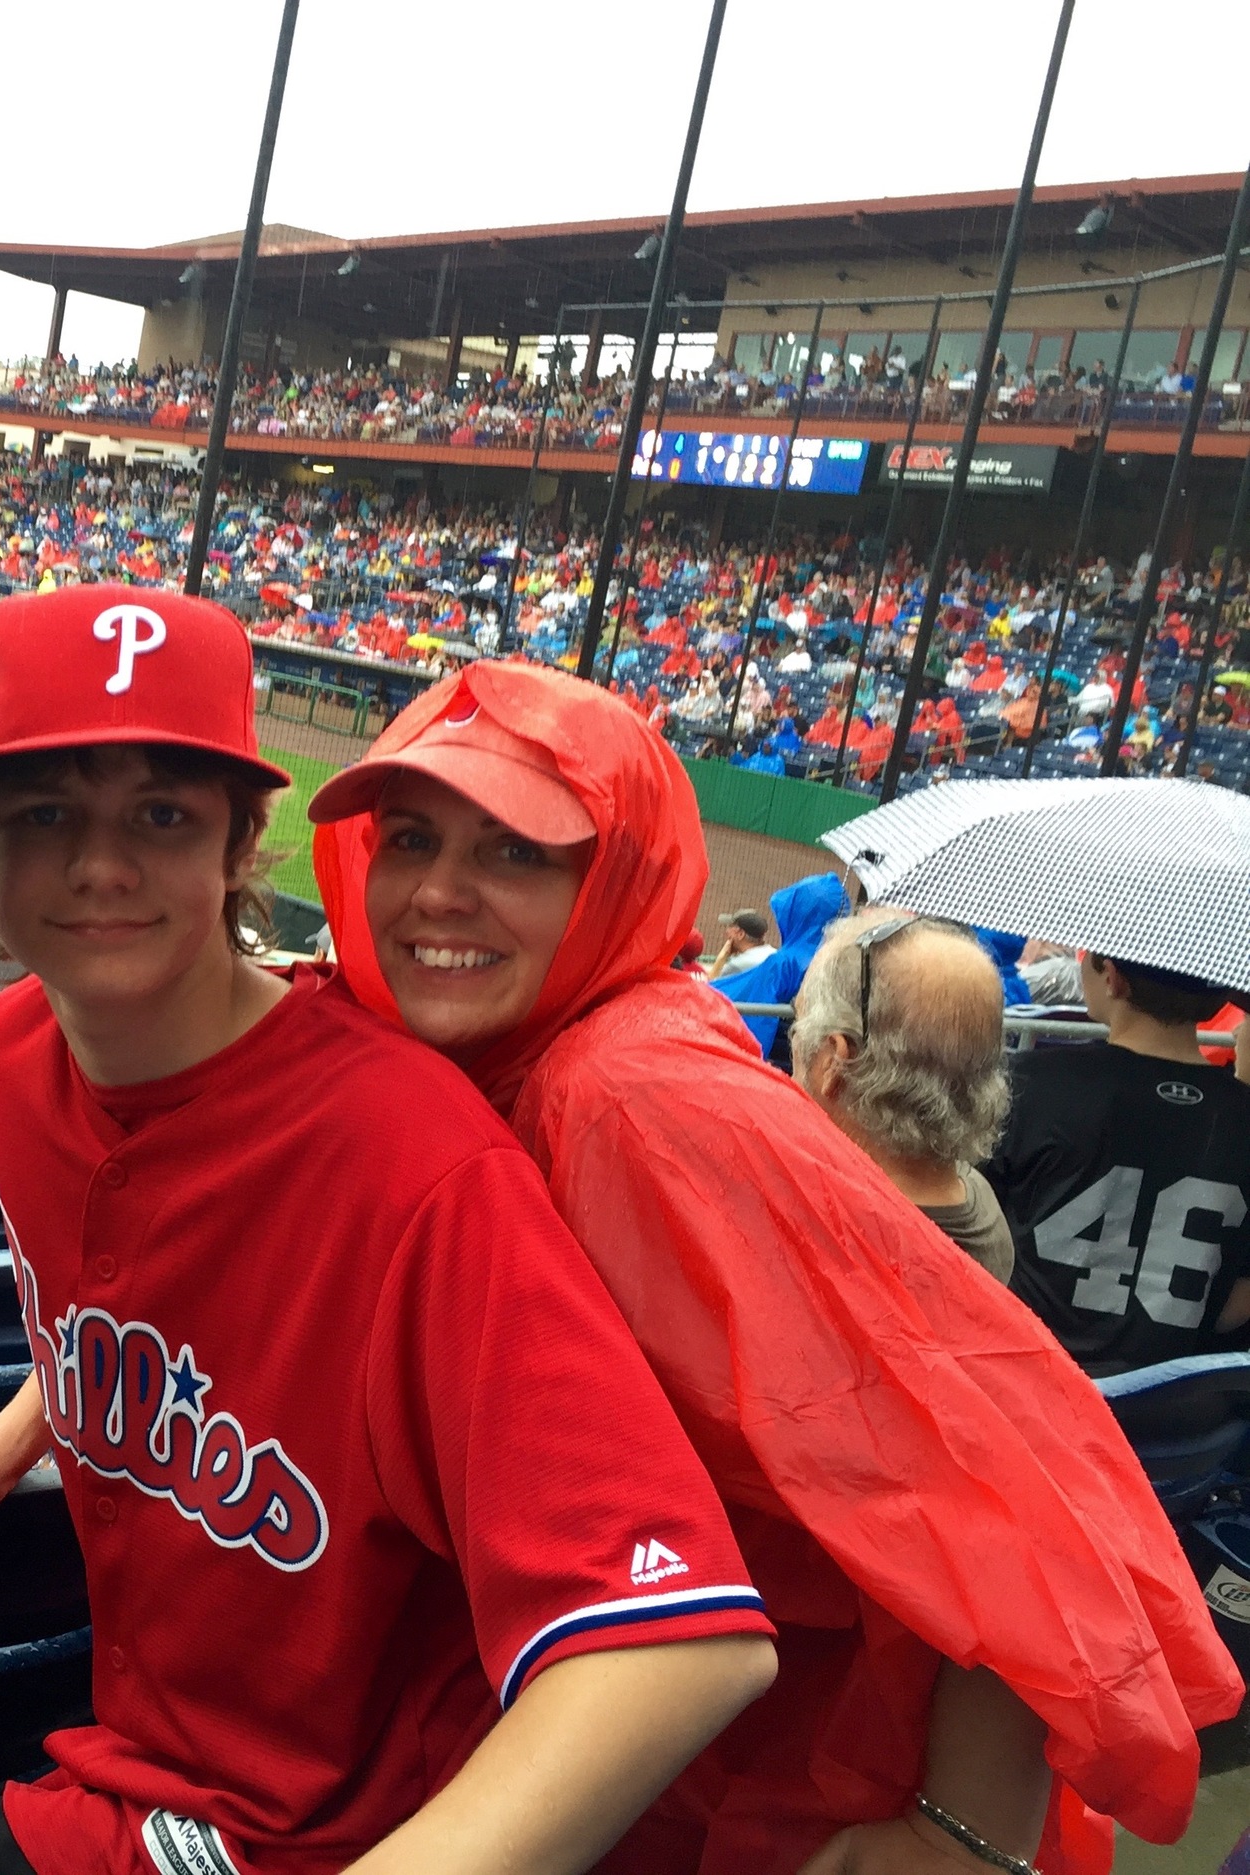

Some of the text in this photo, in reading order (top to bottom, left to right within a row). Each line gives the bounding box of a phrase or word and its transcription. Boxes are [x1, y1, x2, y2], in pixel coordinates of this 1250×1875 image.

[93, 604, 167, 695] P
[1034, 1165, 1248, 1329] 46
[631, 1561, 689, 1586] Majestic
[154, 1817, 170, 1847] MAJOR
